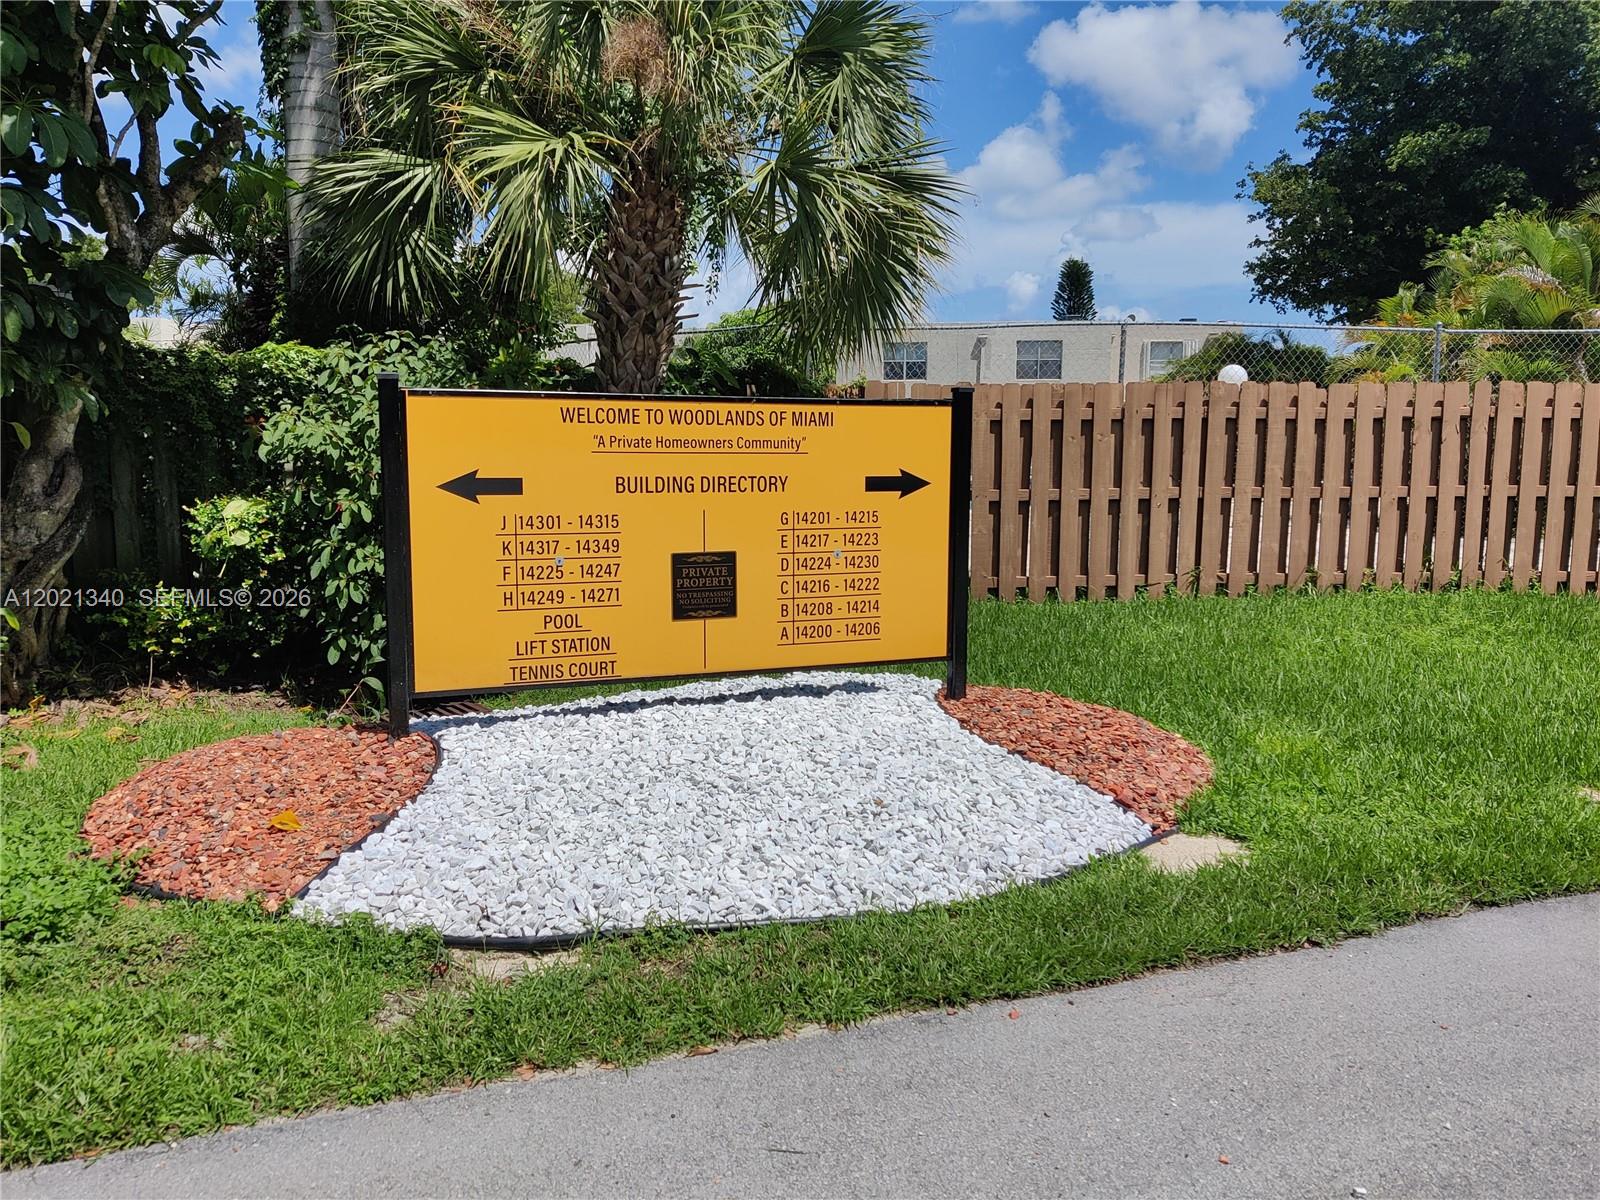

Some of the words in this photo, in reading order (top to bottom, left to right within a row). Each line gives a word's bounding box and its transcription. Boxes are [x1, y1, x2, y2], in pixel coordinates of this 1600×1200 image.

[560, 406, 640, 424] WELCOME
[645, 408, 664, 425] TO
[668, 409, 764, 426] WOODLANDS
[769, 410, 787, 426] OF
[792, 411, 834, 427] MIAMI
[609, 435, 652, 449] Private
[655, 436, 734, 449] Homeowners
[615, 476, 695, 494] BUILDING
[700, 476, 788, 493] DIRECTORY
[501, 516, 506, 530] J
[518, 515, 561, 530] 14301
[578, 514, 620, 529] 14315
[780, 512, 789, 525] G
[795, 512, 830, 524] 14201
[844, 510, 878, 523] 14215
[502, 541, 512, 556] K
[519, 540, 560, 555] 14317
[576, 538, 620, 554] 14349
[781, 536, 788, 548] E
[796, 534, 829, 548] 14217
[842, 532, 879, 546] 14223
[682, 567, 728, 577] PRIVATE
[781, 558, 789, 572] D
[796, 556, 832, 570] 14224
[844, 556, 879, 569] 14230
[503, 566, 511, 581] F
[520, 565, 564, 580] 14225
[580, 564, 620, 578] 14247
[676, 577, 733, 587] PROPERTY
[780, 582, 789, 594] C
[796, 579, 830, 593] 14216
[844, 578, 880, 590] 14222
[504, 592, 513, 606] H
[520, 590, 564, 605] 14249
[582, 588, 620, 602] 14271
[781, 604, 789, 617] B
[796, 602, 832, 616] 14208
[847, 600, 880, 614] 14214
[544, 614, 582, 630] POOL
[780, 628, 789, 640] A
[796, 625, 832, 639] 14200
[845, 622, 880, 636] 14206
[516, 640, 547, 656] LIFT
[552, 637, 610, 654] STATION
[510, 665, 564, 682] TENNIS
[568, 661, 616, 678] COURT
